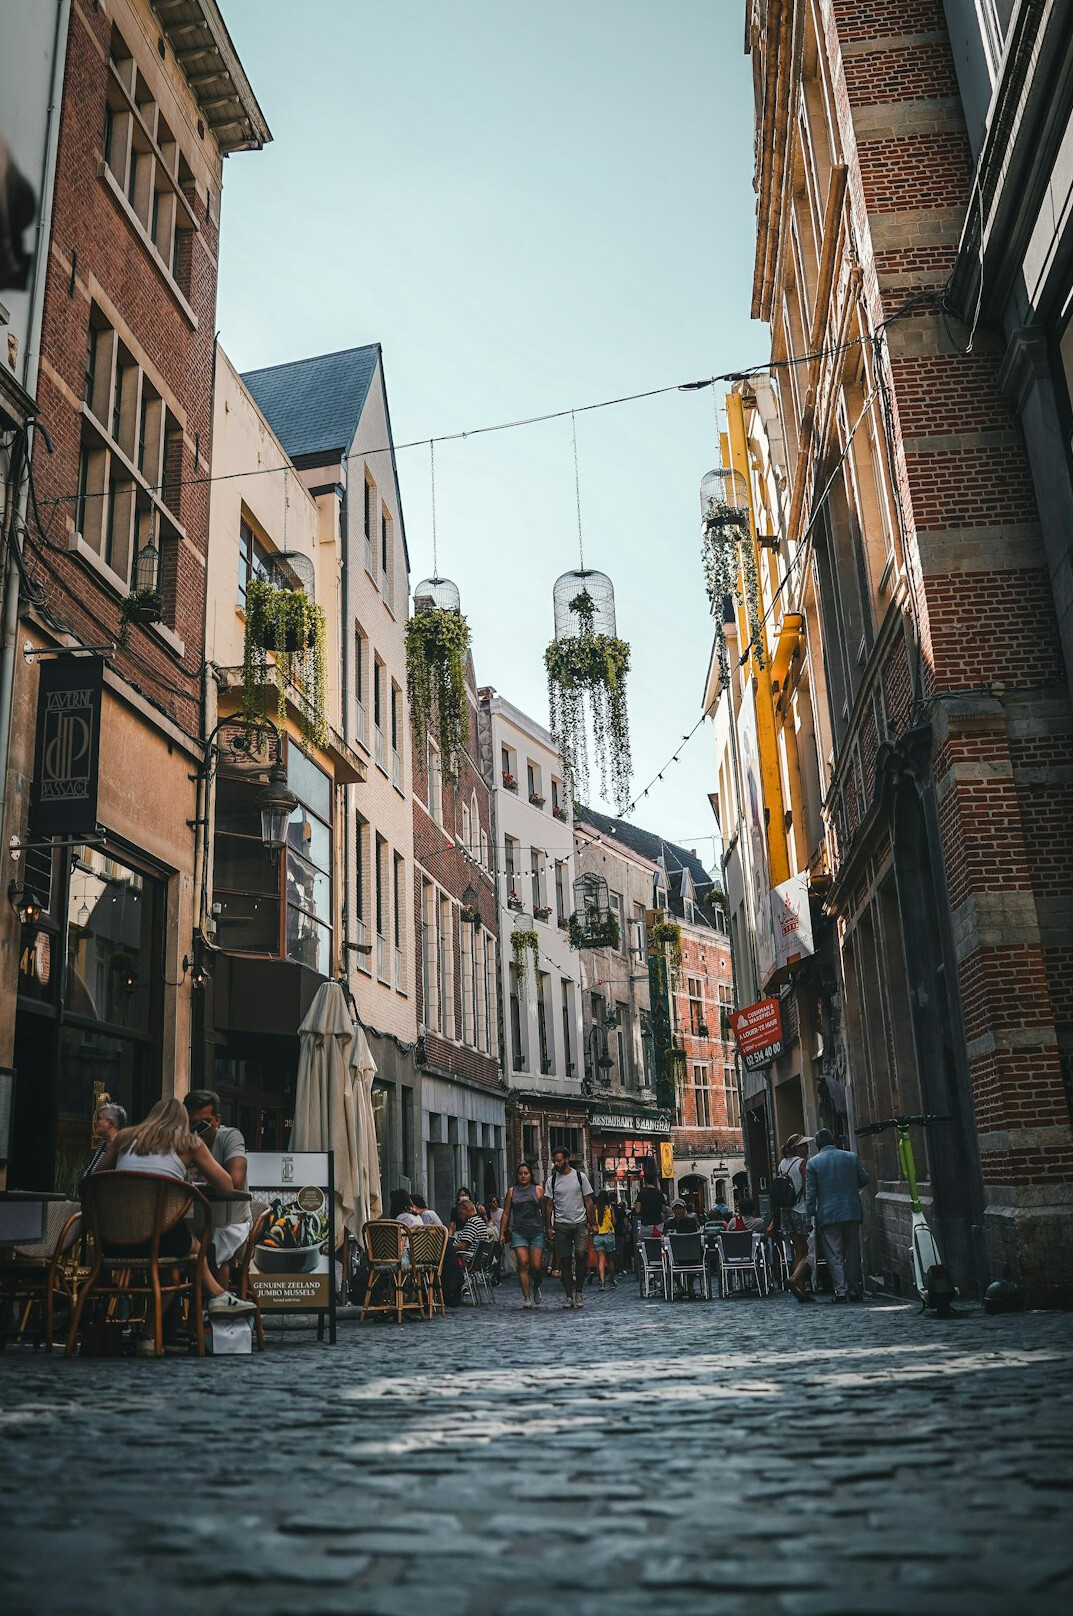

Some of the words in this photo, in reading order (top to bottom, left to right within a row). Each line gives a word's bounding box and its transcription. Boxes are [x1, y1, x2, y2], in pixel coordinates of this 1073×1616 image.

[46, 689, 95, 709] TAVERNE
[42, 780, 92, 798] PASSAGE
[20, 947, 35, 977] 41
[747, 1005, 770, 1019] CUSHMAN
[748, 1009, 775, 1024] WAKEFIELD
[765, 1018, 778, 1028] HUUR
[746, 1055, 754, 1066] 02
[754, 1049, 764, 1063] 514
[765, 1046, 772, 1057] 40
[773, 1042, 781, 1054] 00
[592, 1114, 634, 1128] RESTAURANT
[635, 1118, 671, 1131] SHANGHAI
[257, 1289, 282, 1297] JUMBO
[287, 1281, 320, 1289] ZEELAND
